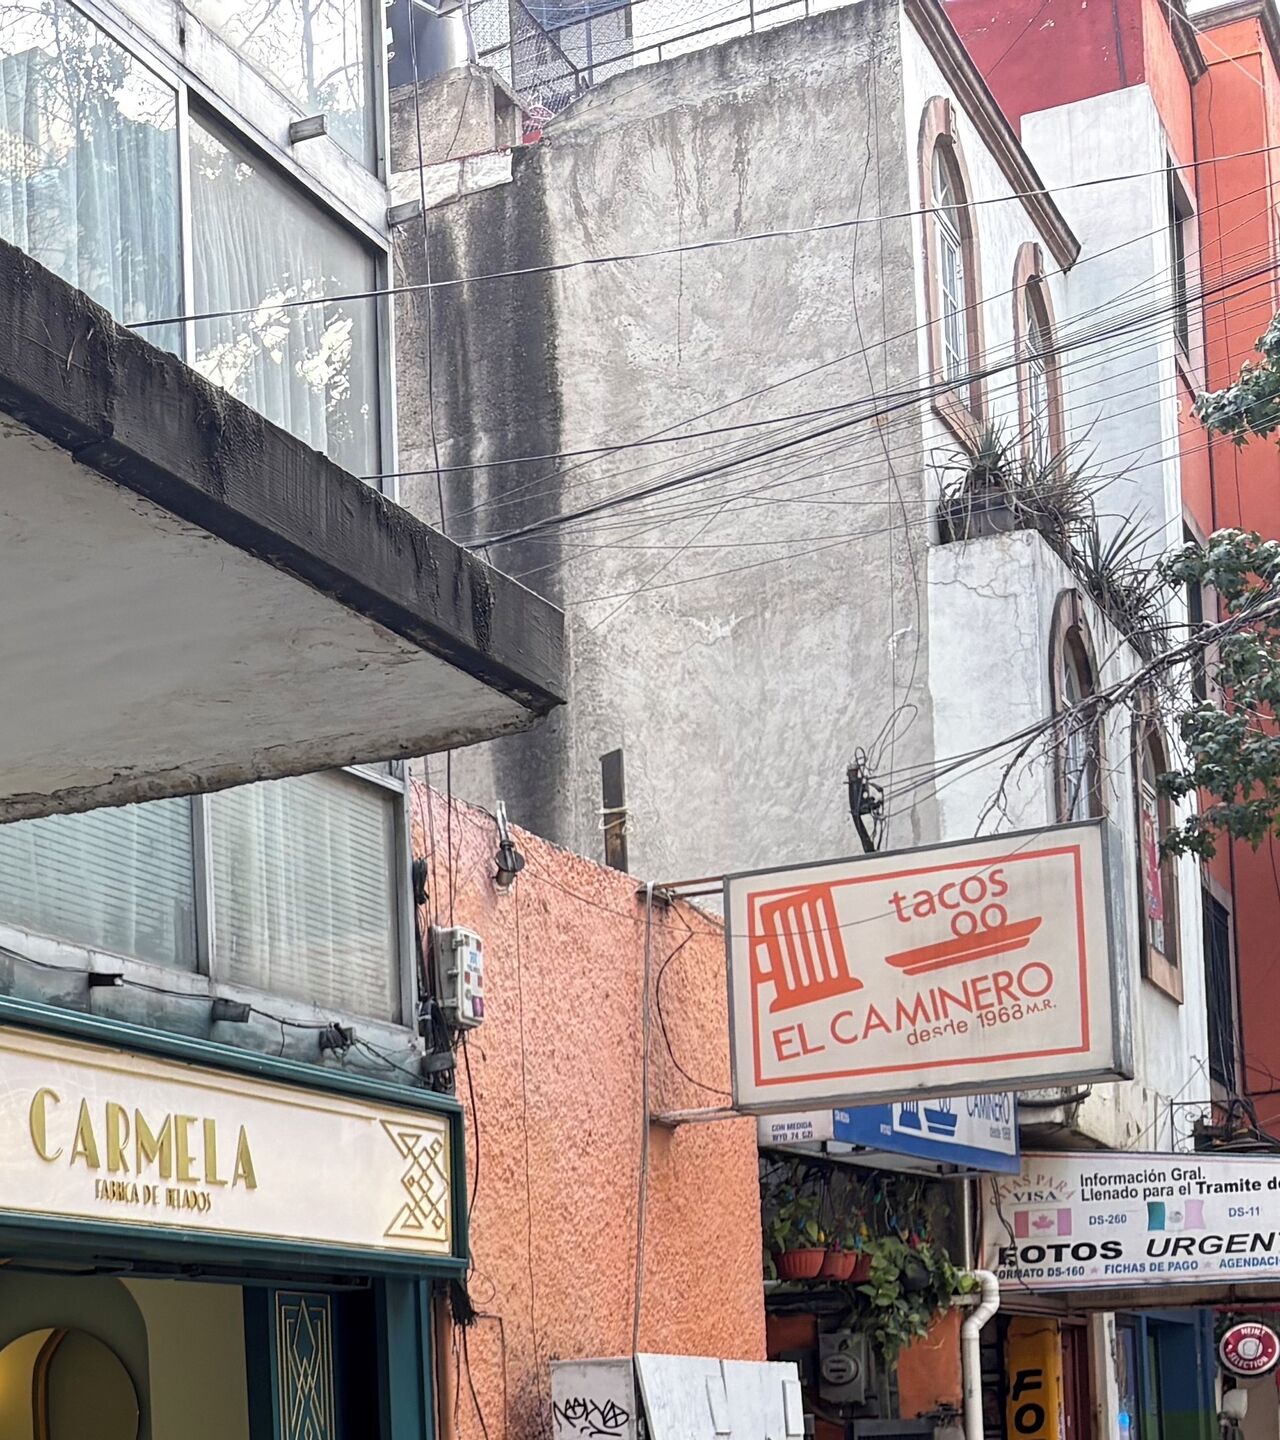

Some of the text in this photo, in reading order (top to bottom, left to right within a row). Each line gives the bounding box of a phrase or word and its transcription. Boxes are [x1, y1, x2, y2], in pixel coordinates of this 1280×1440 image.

[888, 868, 1009, 923] tacos
[773, 961, 1054, 1062] EL CAMINERO
[906, 1018, 969, 1046] desde
[29, 1086, 258, 1190] CARMELA
[1080, 1166, 1206, 1188] Información Gral.
[143, 1184, 160, 1205] DE
[1013, 1191, 1057, 1202] VISA
[1080, 1186, 1138, 1202] Llenado
[1143, 1185, 1174, 1201] para
[1178, 1182, 1191, 1195] el
[1195, 1177, 1261, 1195] Tramite
[1089, 1214, 1127, 1226] DS-260
[1228, 1206, 1260, 1218] DS-11
[998, 1232, 1280, 1265] FOTOS URGEN
[1104, 1262, 1146, 1275] FICHAS
[1149, 1261, 1165, 1272] DE
[1167, 1260, 1199, 1272] PAGO
